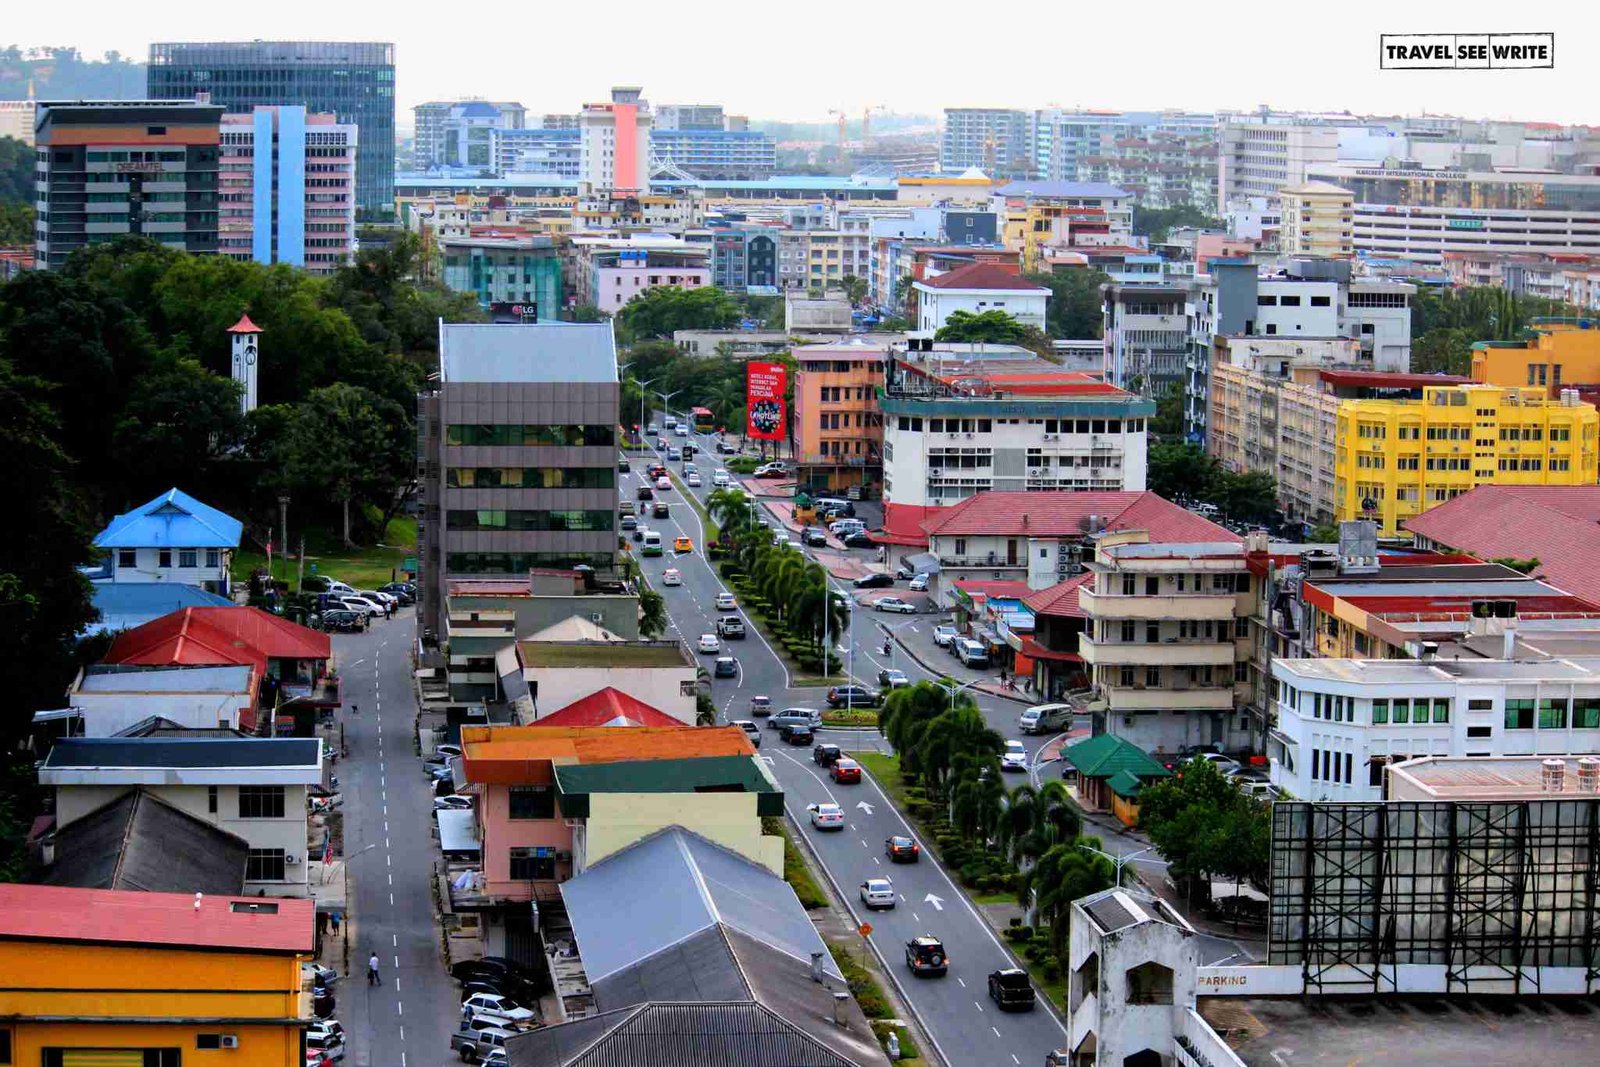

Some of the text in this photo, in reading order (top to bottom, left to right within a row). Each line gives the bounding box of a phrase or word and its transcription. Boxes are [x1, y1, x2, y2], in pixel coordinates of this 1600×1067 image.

[117, 162, 165, 172] DREAMTEL
[1386, 170, 1435, 178] INTERNATIONAL
[1198, 976, 1247, 986] PARKING
